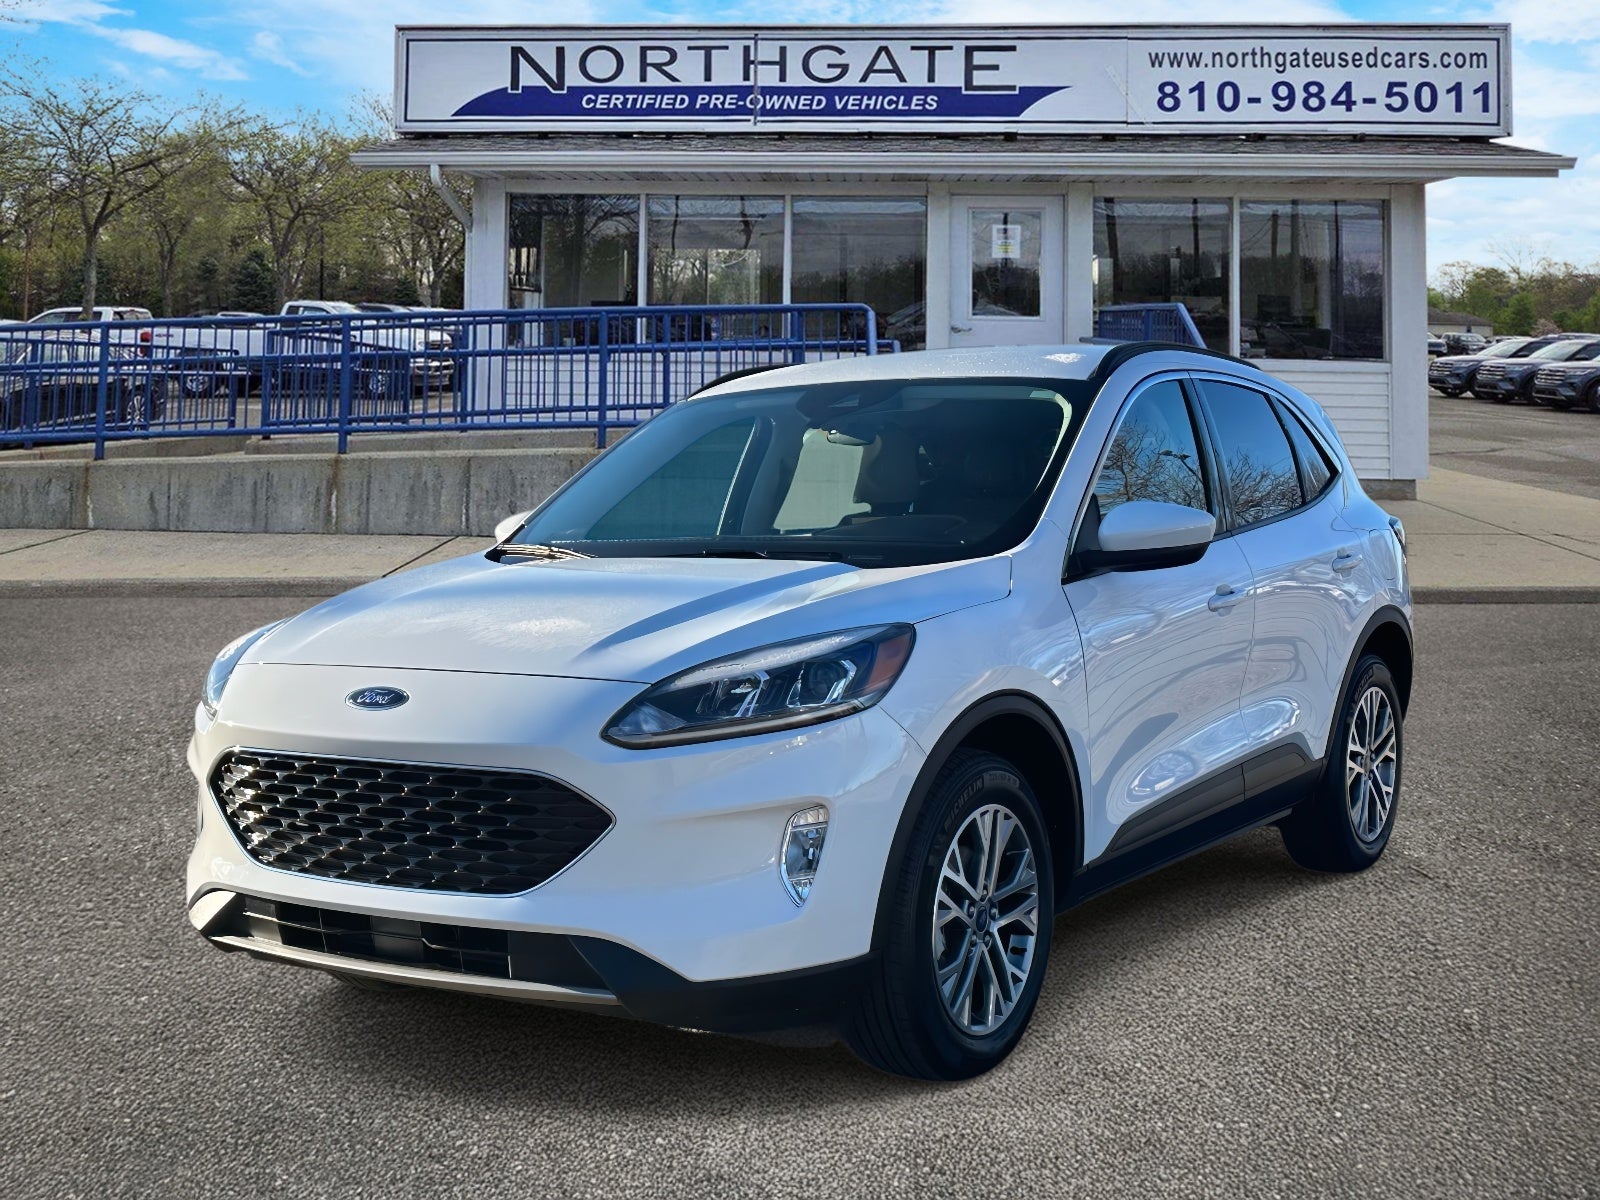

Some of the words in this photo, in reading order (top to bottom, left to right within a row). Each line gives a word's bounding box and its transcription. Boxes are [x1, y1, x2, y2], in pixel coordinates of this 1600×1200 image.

[510, 44, 1017, 92] NORTHGATE
[1148, 46, 1488, 74] www.northgateusedcars.com
[581, 94, 690, 110] CERTIFIED
[695, 94, 827, 111] PRE-OWNED
[835, 95, 939, 111] VEHICLES
[1156, 80, 1491, 113] 810-984-5011
